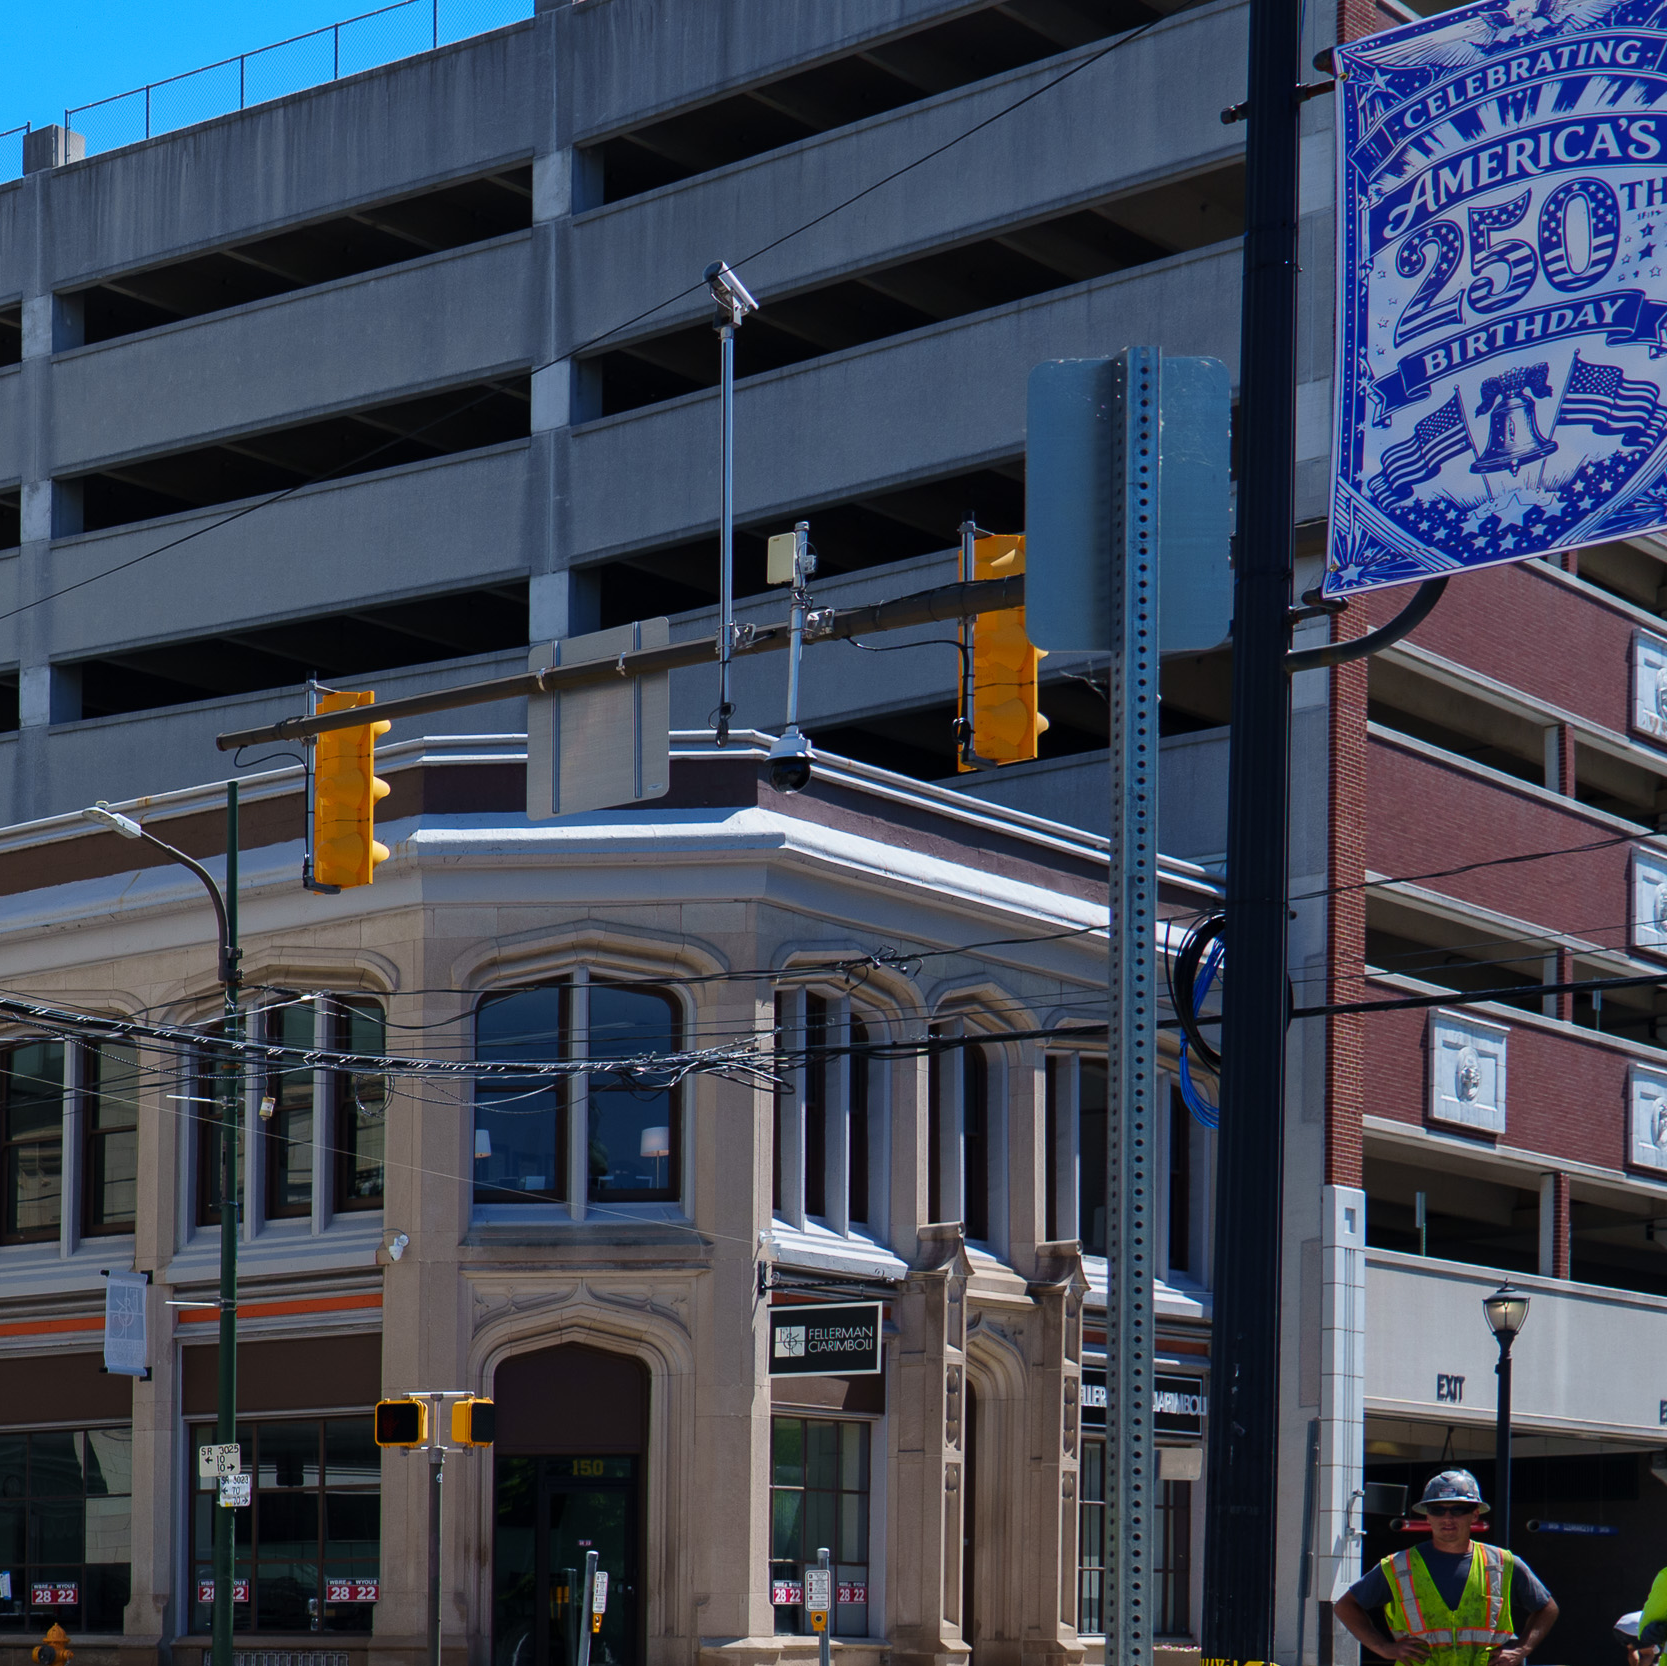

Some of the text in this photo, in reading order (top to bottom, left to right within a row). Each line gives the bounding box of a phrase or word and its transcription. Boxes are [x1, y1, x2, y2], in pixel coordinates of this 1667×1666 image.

[1403, 37, 1643, 129] CELEBRATING
[1383, 118, 1662, 240] AMERICA'S
[1423, 296, 1626, 379] BIRTHDAY
[808, 1326, 873, 1340] FELLERMAN
[808, 1339, 873, 1352] CIARIMBOLI
[1437, 1373, 1465, 1403] EXIT
[1152, 1391, 1207, 1416] IARIMBOLI
[201, 1445, 239, 1456] SR 3025
[216, 1455, 225, 1464] 10
[217, 1464, 225, 1472] 10
[572, 1459, 604, 1476] 150
[35, 1590, 74, 1603] 28 22
[330, 1587, 376, 1600] 28 22
[775, 1589, 801, 1602] 28 22
[839, 1589, 865, 1602] 28 22
